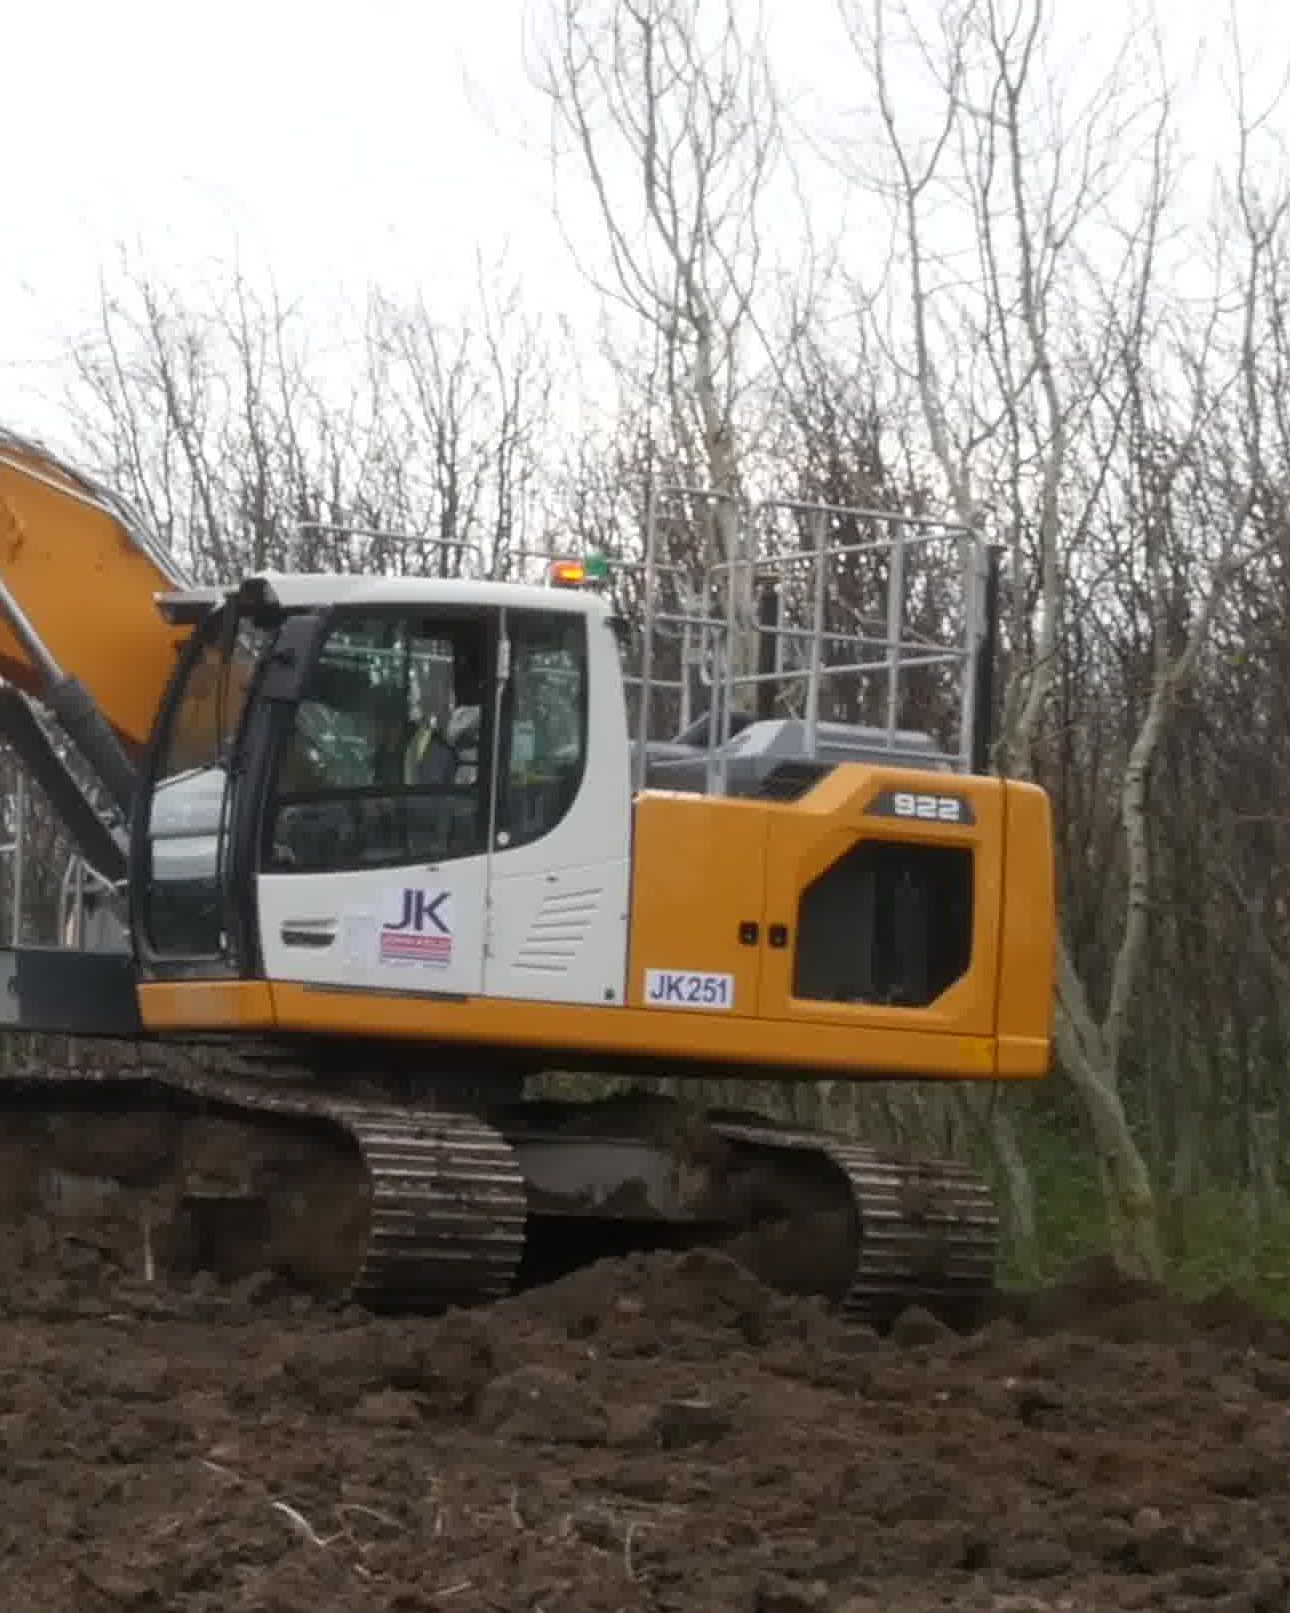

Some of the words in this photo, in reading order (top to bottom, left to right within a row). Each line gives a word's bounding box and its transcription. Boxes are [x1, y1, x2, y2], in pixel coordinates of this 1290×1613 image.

[894, 792, 960, 821] 922
[382, 888, 453, 933] JK
[650, 974, 728, 1004] JK251
